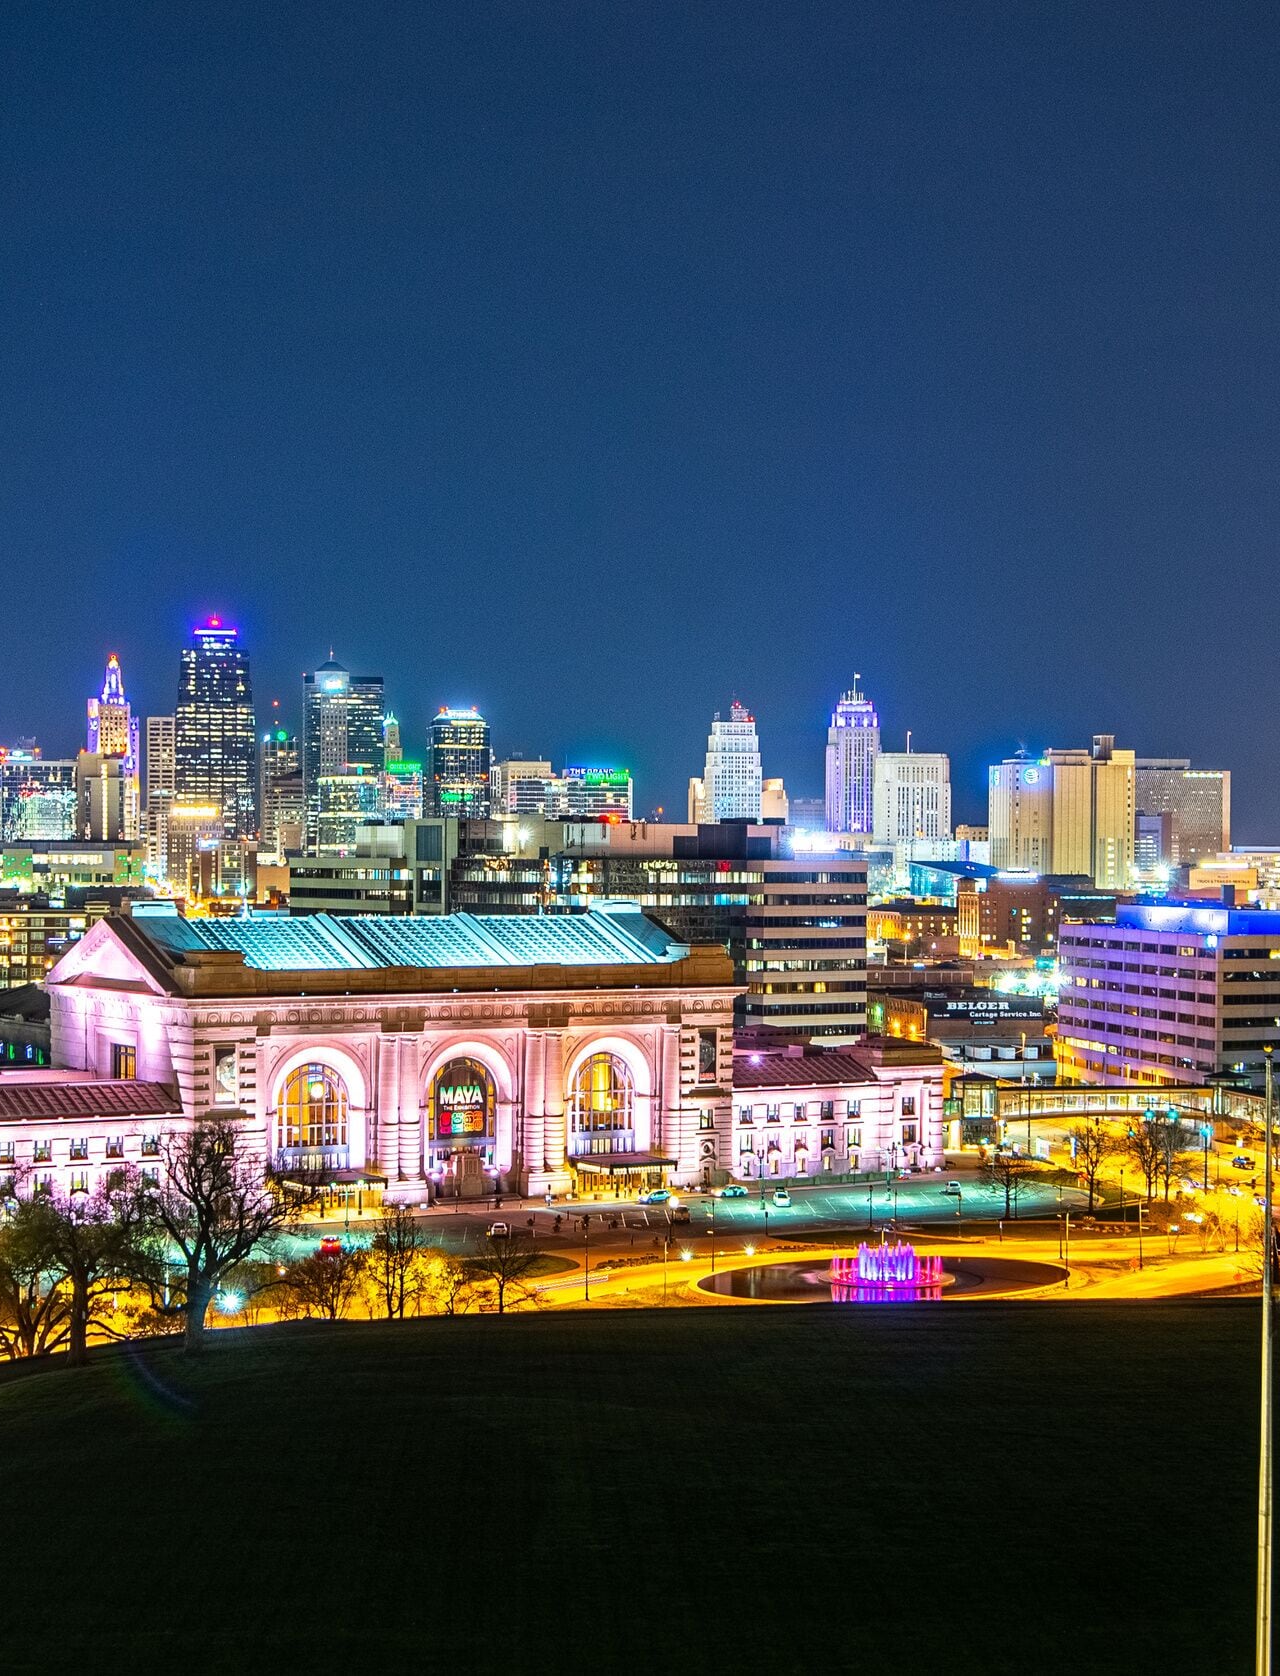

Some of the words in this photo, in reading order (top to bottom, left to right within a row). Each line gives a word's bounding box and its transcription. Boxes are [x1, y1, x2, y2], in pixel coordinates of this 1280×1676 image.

[946, 1001, 1010, 1010] BELGER
[969, 1011, 998, 1019] Cartage
[439, 1085, 483, 1105] MAYA
